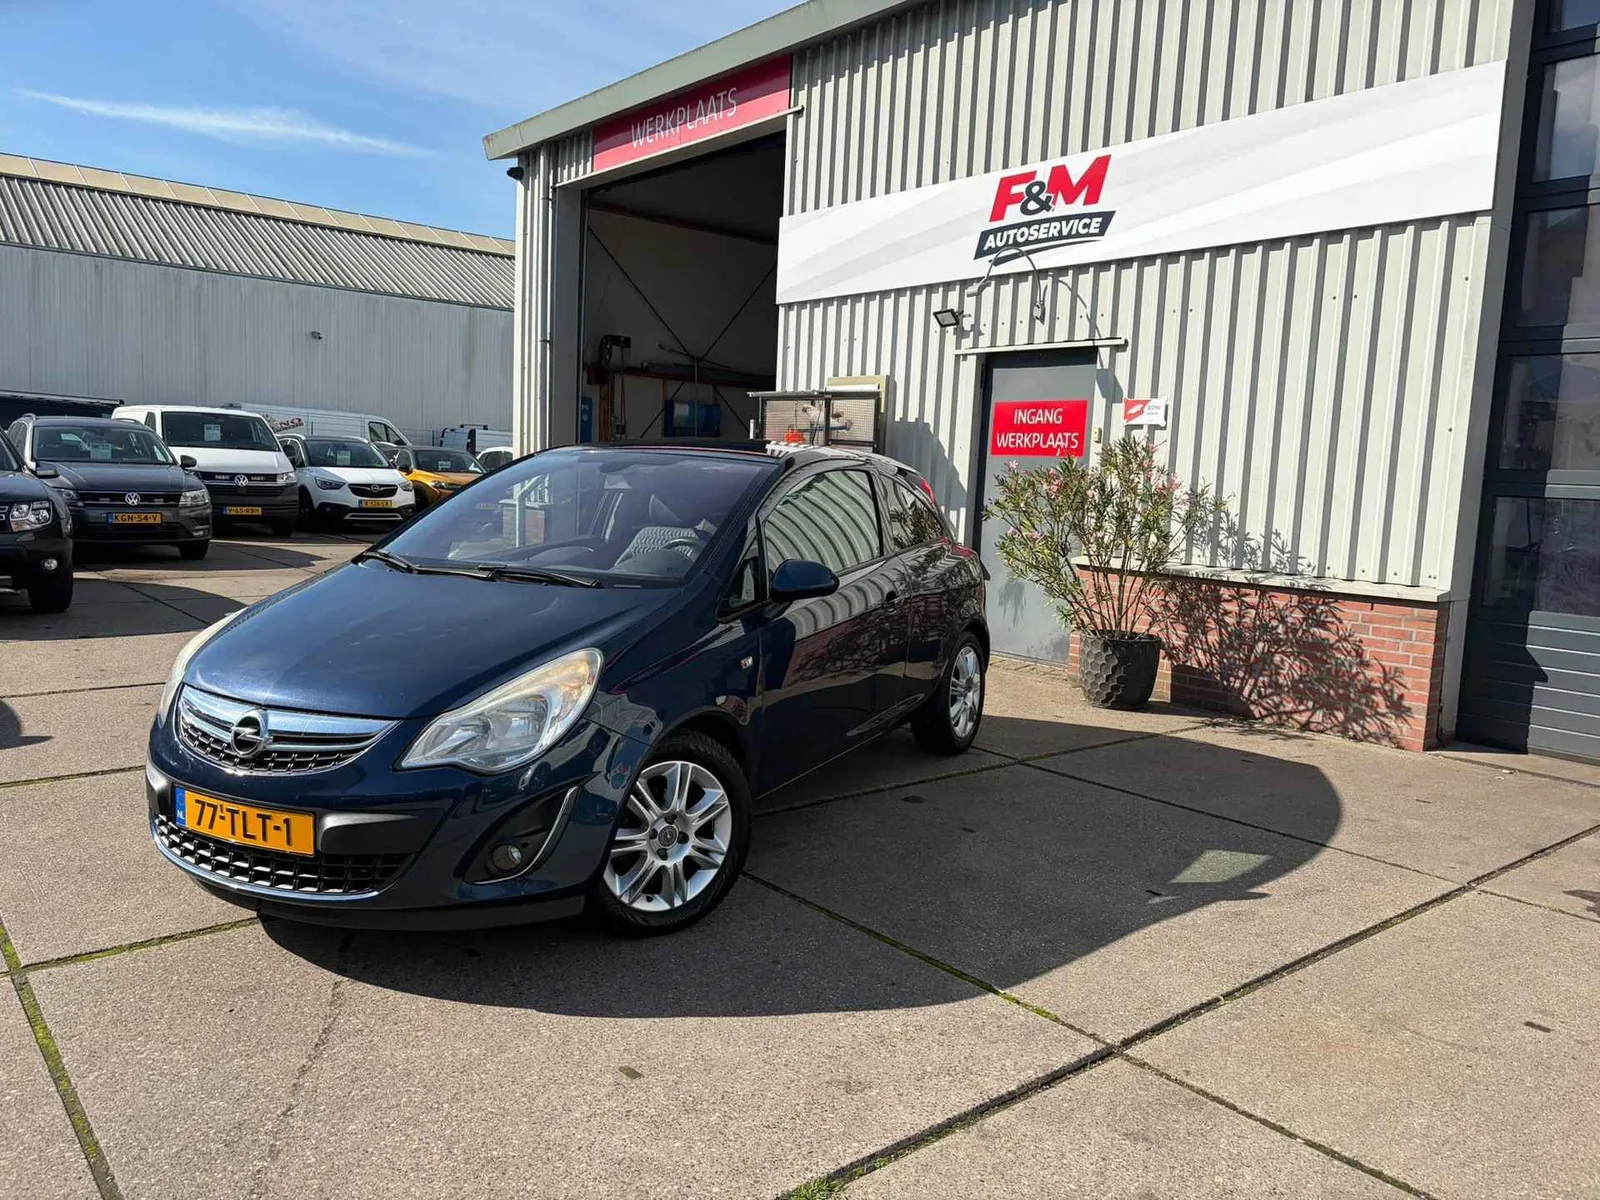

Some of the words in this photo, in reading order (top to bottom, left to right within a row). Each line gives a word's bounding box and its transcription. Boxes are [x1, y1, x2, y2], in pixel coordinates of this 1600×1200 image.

[631, 87, 738, 149] WERKPLAATS
[989, 154, 1112, 223] F&M
[983, 217, 1103, 250] AUTOSERVICE
[1013, 408, 1064, 425] INGANG
[996, 432, 1079, 449] WERKPLAATS
[114, 514, 158, 522] KGN-54-V
[194, 799, 293, 846] 77-TLT-1
